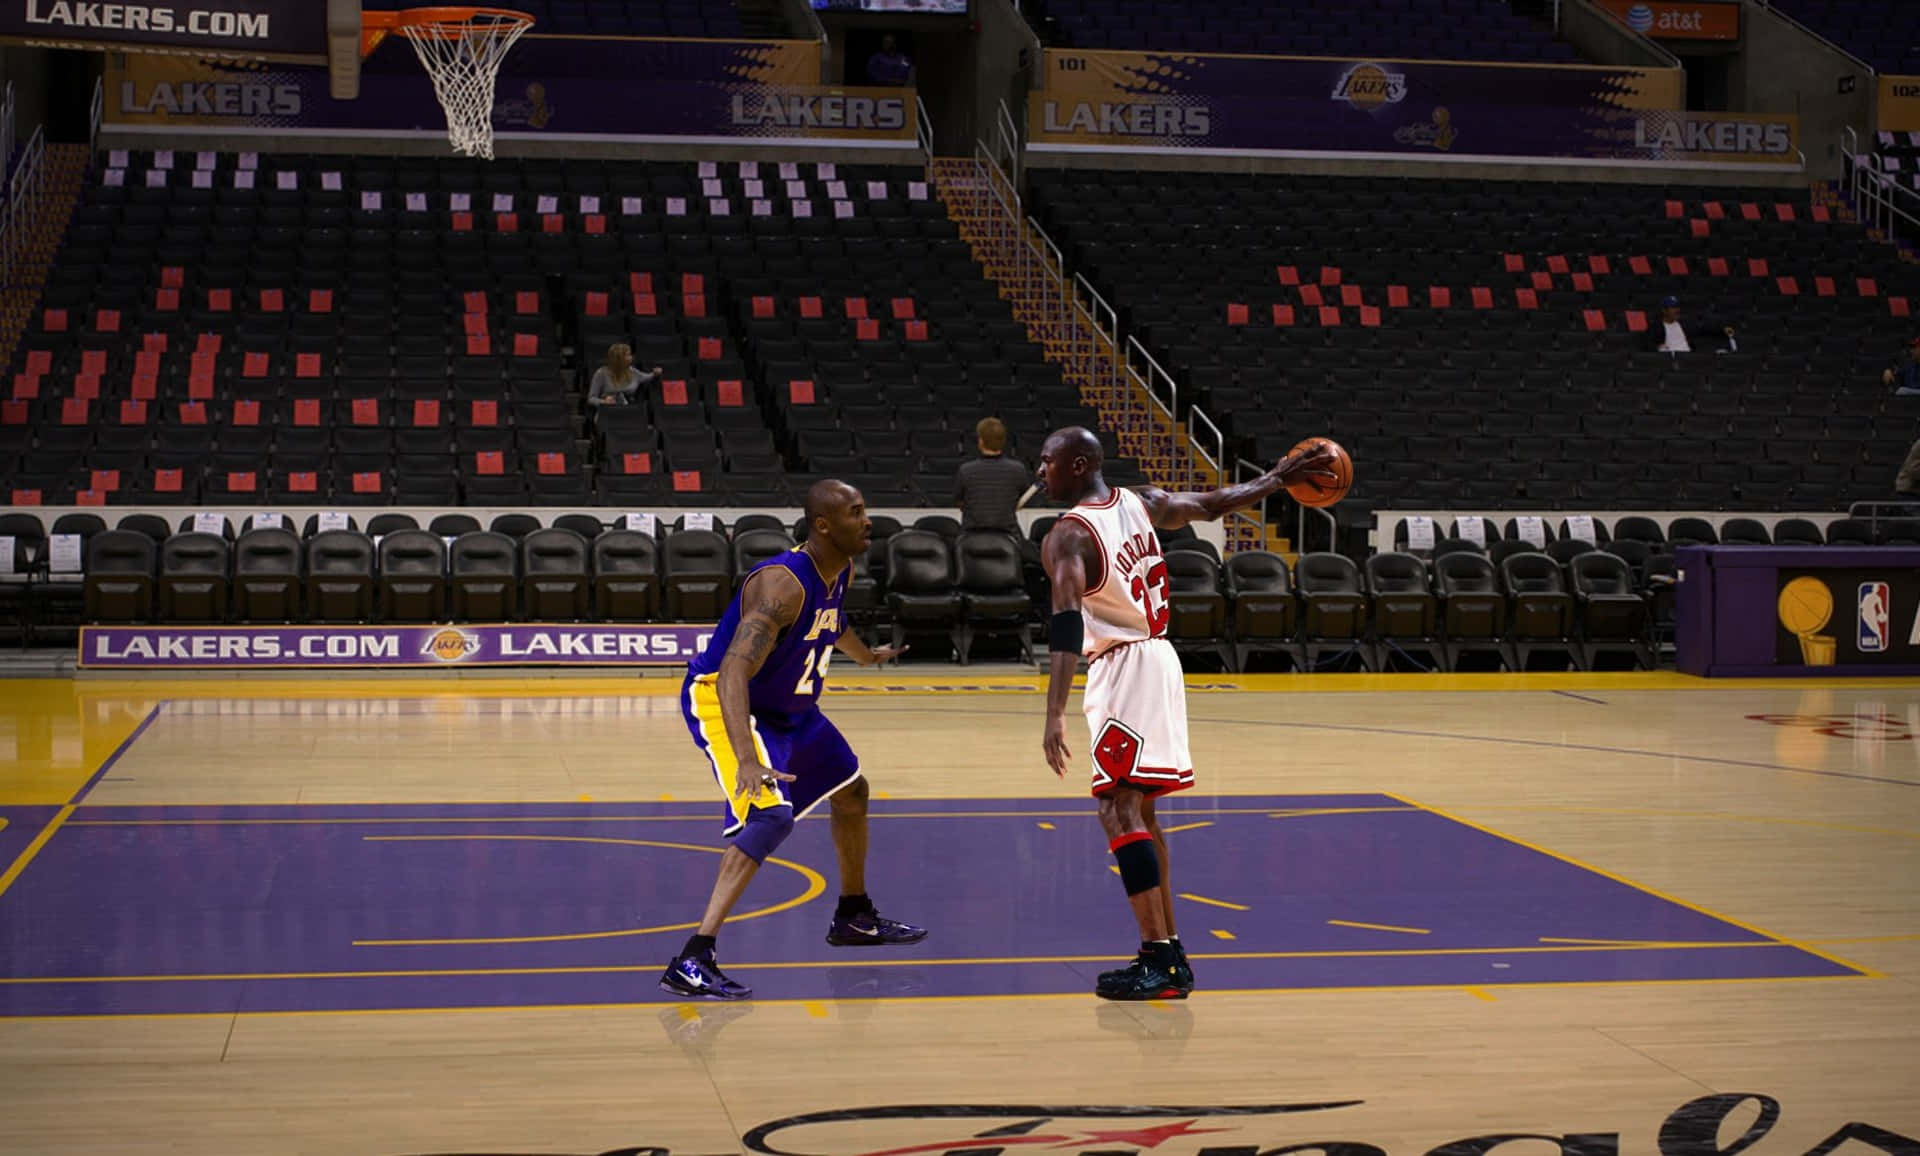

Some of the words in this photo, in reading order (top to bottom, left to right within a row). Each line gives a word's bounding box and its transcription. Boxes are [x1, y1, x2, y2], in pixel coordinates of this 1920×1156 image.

[26, 0, 269, 38] LAKERS.COM
[1658, 11, 1702, 31] at&t
[1058, 58, 1087, 72] 101
[121, 82, 301, 117] LAKERS
[731, 95, 905, 128] LAKERS
[1044, 103, 1210, 137] LAKERS
[1635, 120, 1792, 153] LAKERS
[1115, 531, 1164, 583] JORDA
[1130, 560, 1170, 637] 23
[96, 635, 399, 659] LAKERS.COM
